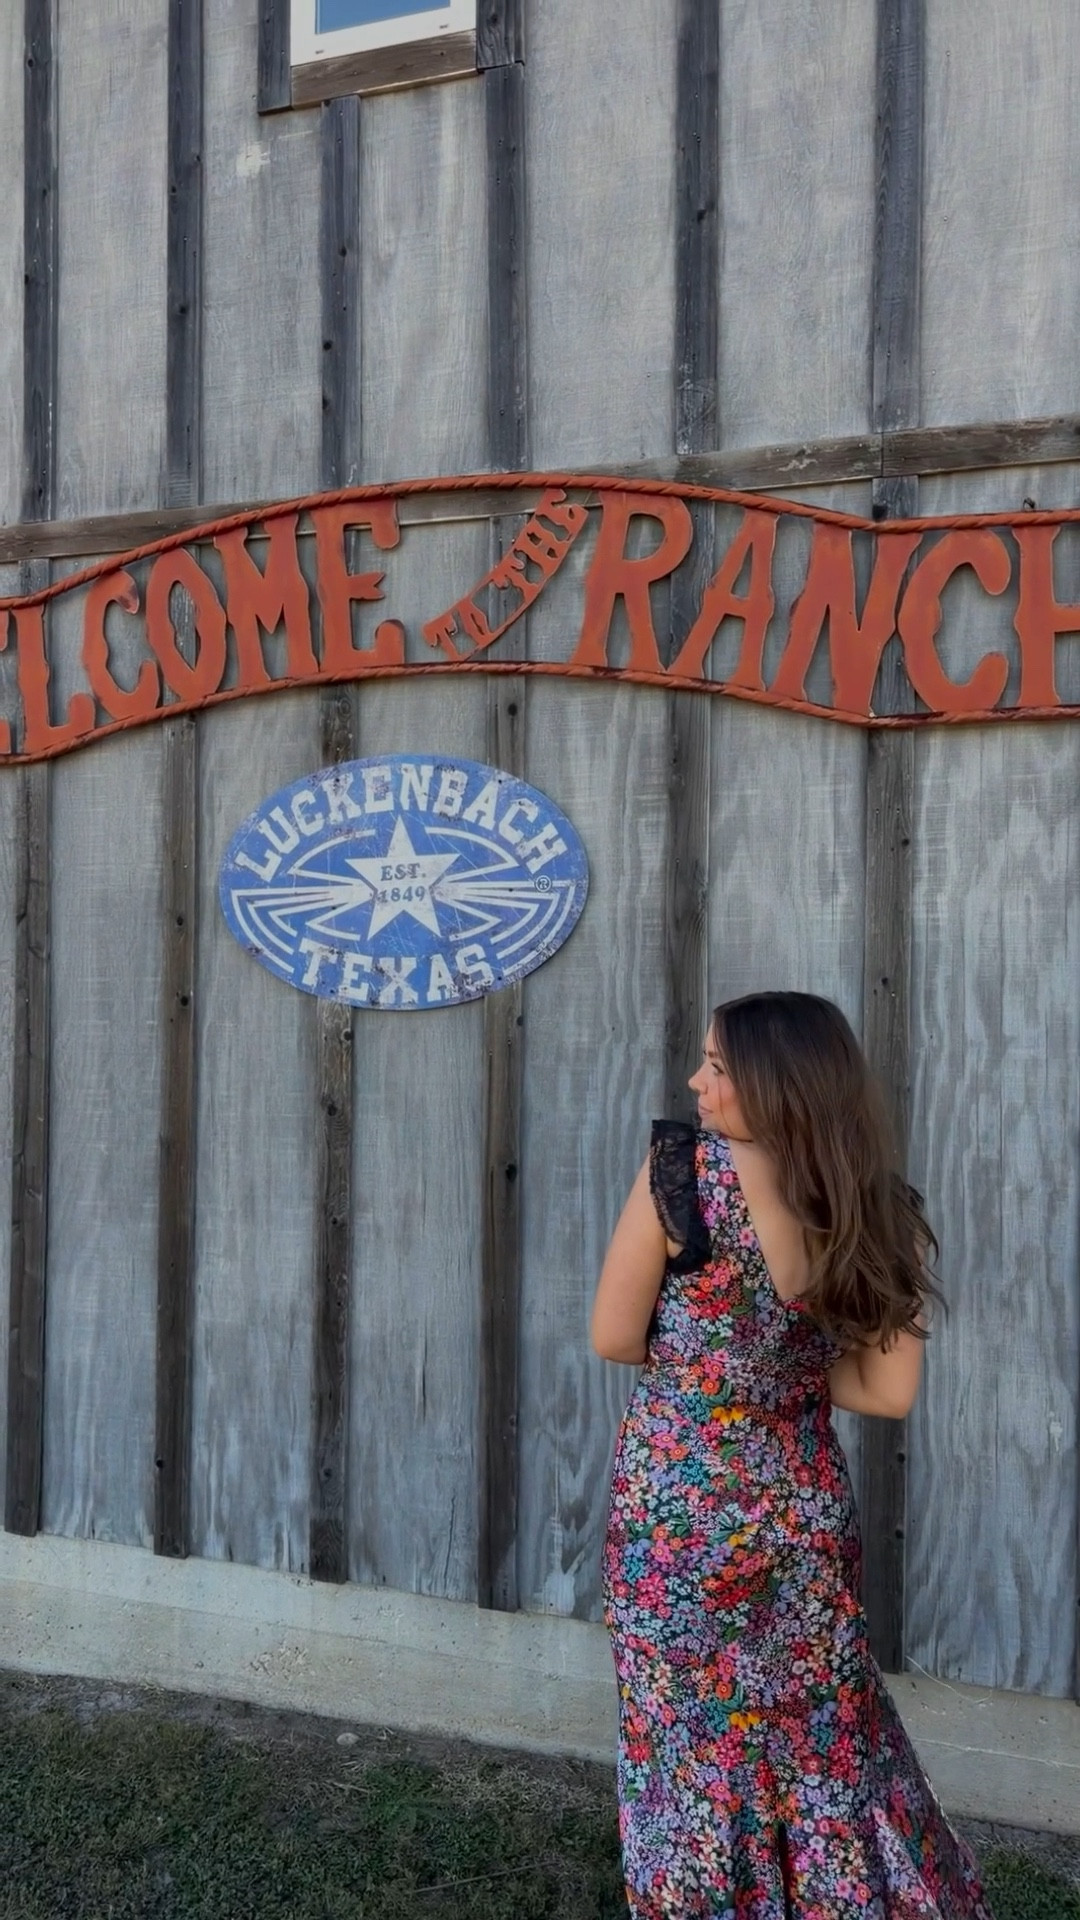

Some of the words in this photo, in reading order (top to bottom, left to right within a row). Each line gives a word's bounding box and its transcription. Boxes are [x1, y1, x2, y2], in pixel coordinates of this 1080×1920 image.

[0, 499, 405, 755] LCOME
[422, 598, 497, 662] TO
[489, 487, 589, 602] THE
[234, 763, 568, 882] LUCKENBACH
[376, 885, 426, 903] 1849
[380, 863, 426, 881] EST.
[298, 938, 496, 1005] TEXAS
